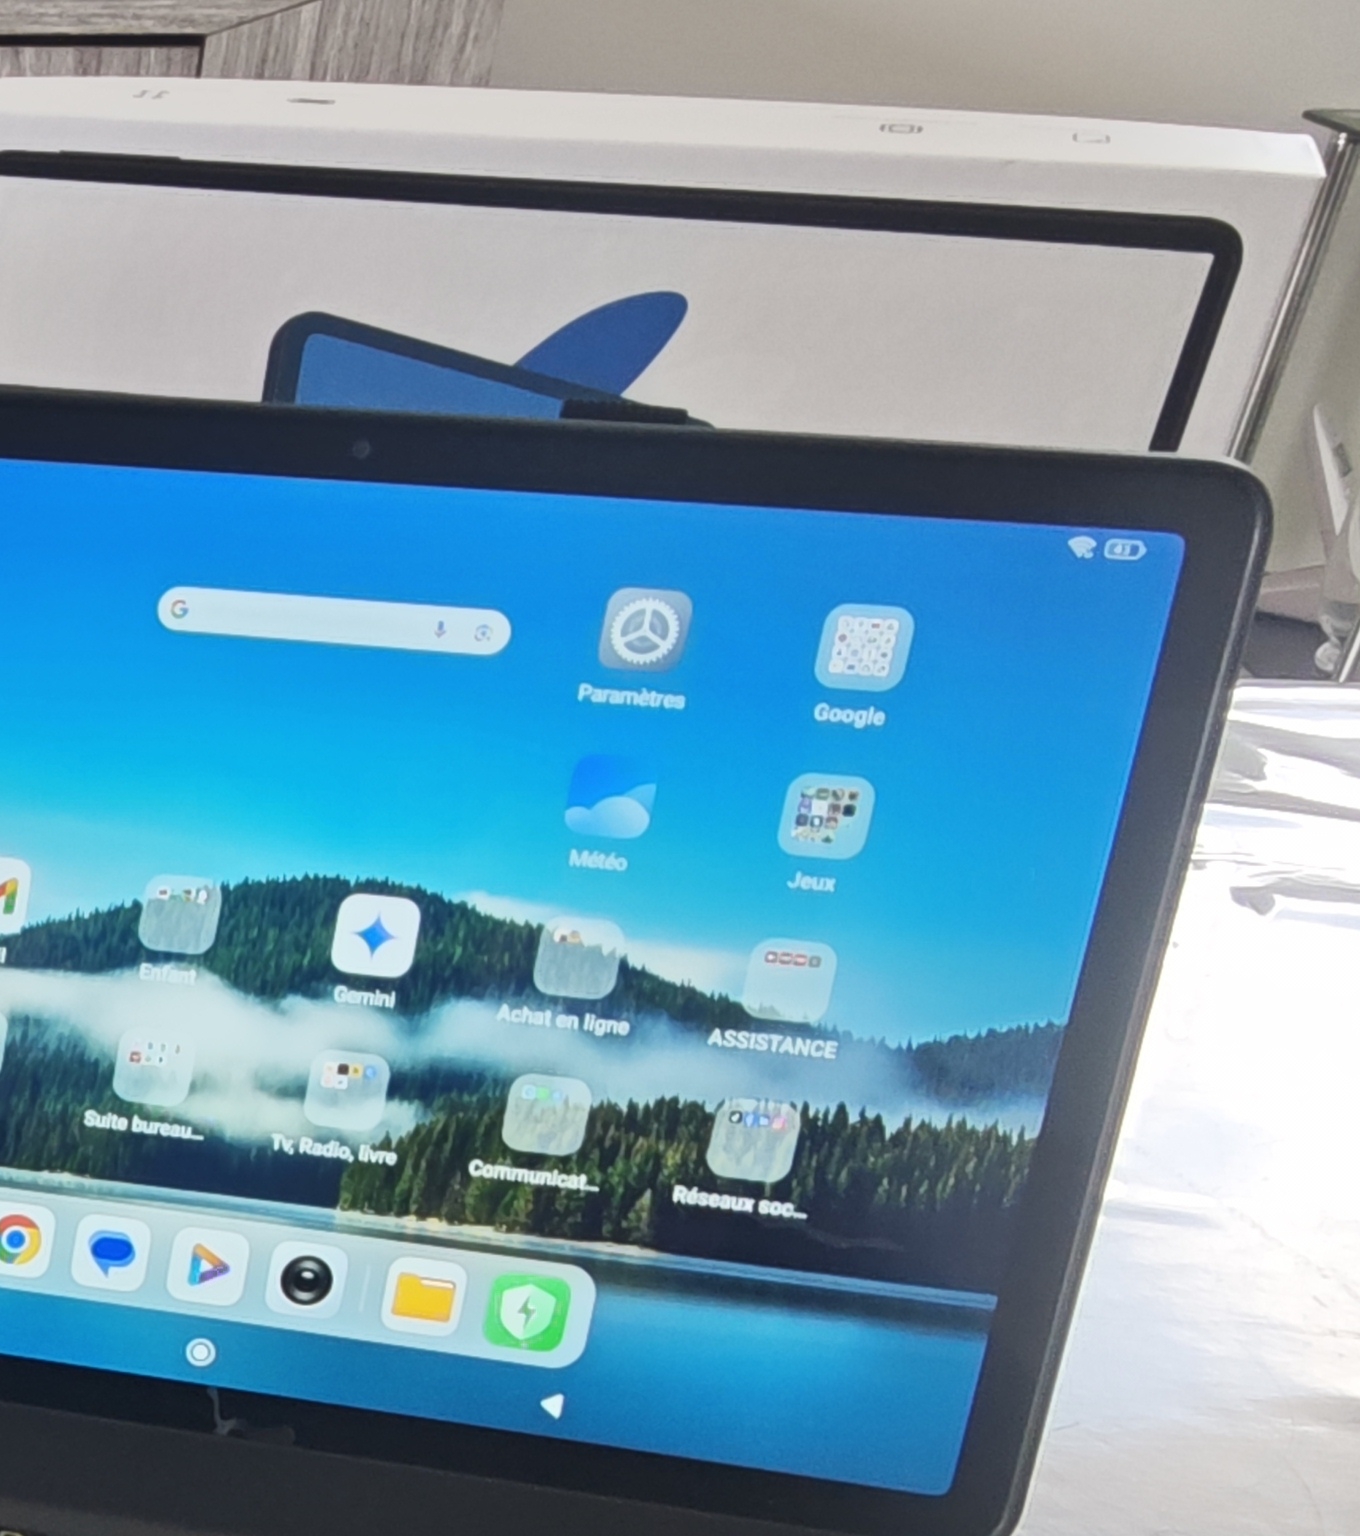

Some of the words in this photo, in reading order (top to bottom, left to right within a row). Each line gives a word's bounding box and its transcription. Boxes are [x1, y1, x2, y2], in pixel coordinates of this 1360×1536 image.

[577, 682, 686, 710] Paramètres
[814, 702, 886, 729] Google
[569, 848, 628, 872] Météo
[786, 871, 836, 893] Jeux
[139, 962, 197, 985] Enfant
[333, 985, 396, 1009] Gemini
[497, 1003, 552, 1027] Achat
[556, 1014, 579, 1030] en
[584, 1013, 631, 1036] ligne
[707, 1028, 838, 1060] ASSISTANCE
[84, 1109, 128, 1132] Suite
[299, 1136, 354, 1162] Radio,
[358, 1144, 398, 1167] livre
[672, 1185, 755, 1212] Réseaux
